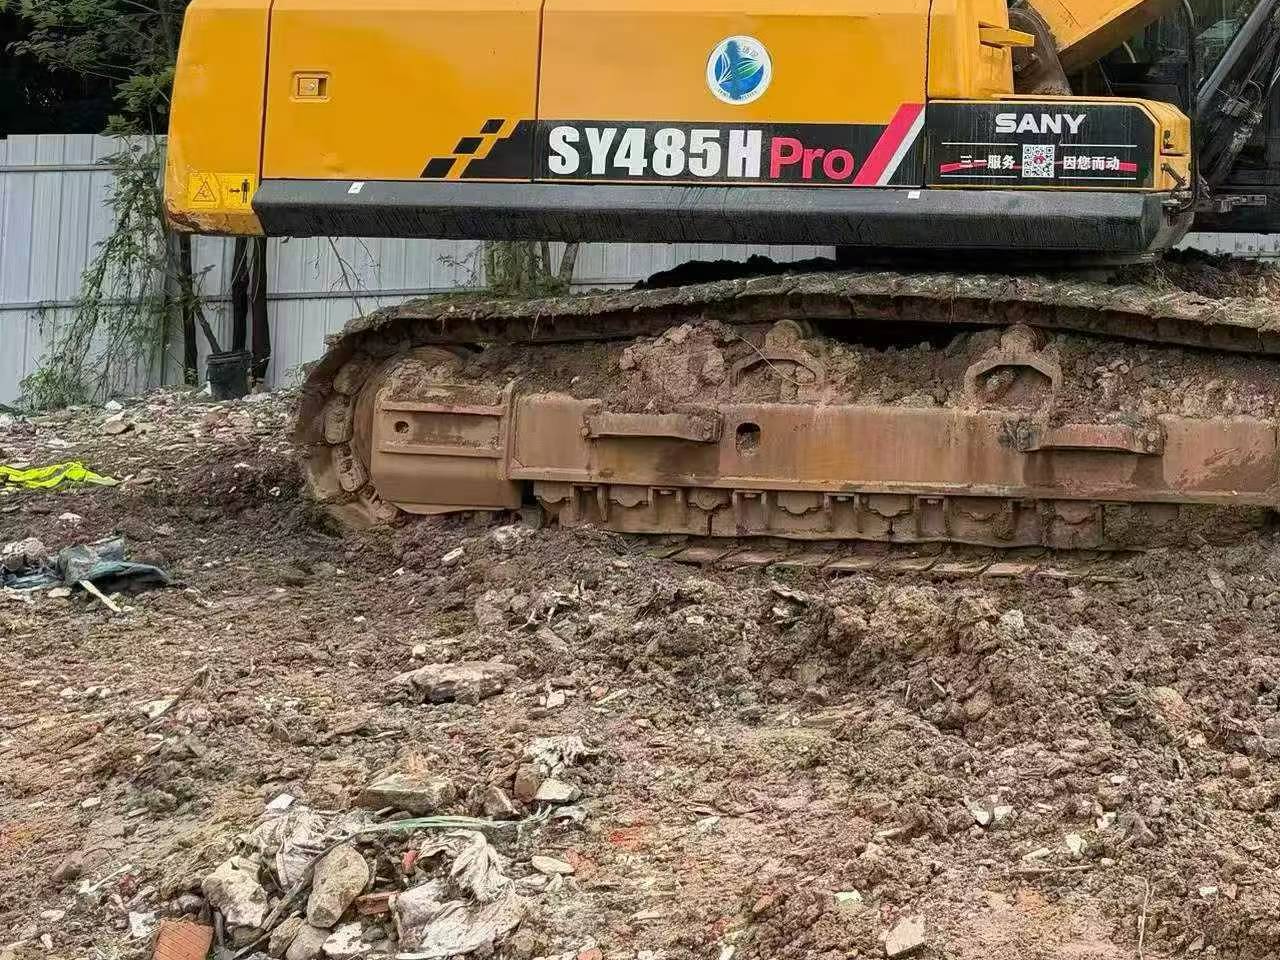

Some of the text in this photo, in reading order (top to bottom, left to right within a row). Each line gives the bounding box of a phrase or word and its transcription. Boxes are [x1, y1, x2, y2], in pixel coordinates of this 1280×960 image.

[995, 113, 1087, 134] SANY
[548, 125, 854, 180] SY485H Pro
[959, 154, 1120, 171] 三一服务 因您而动
